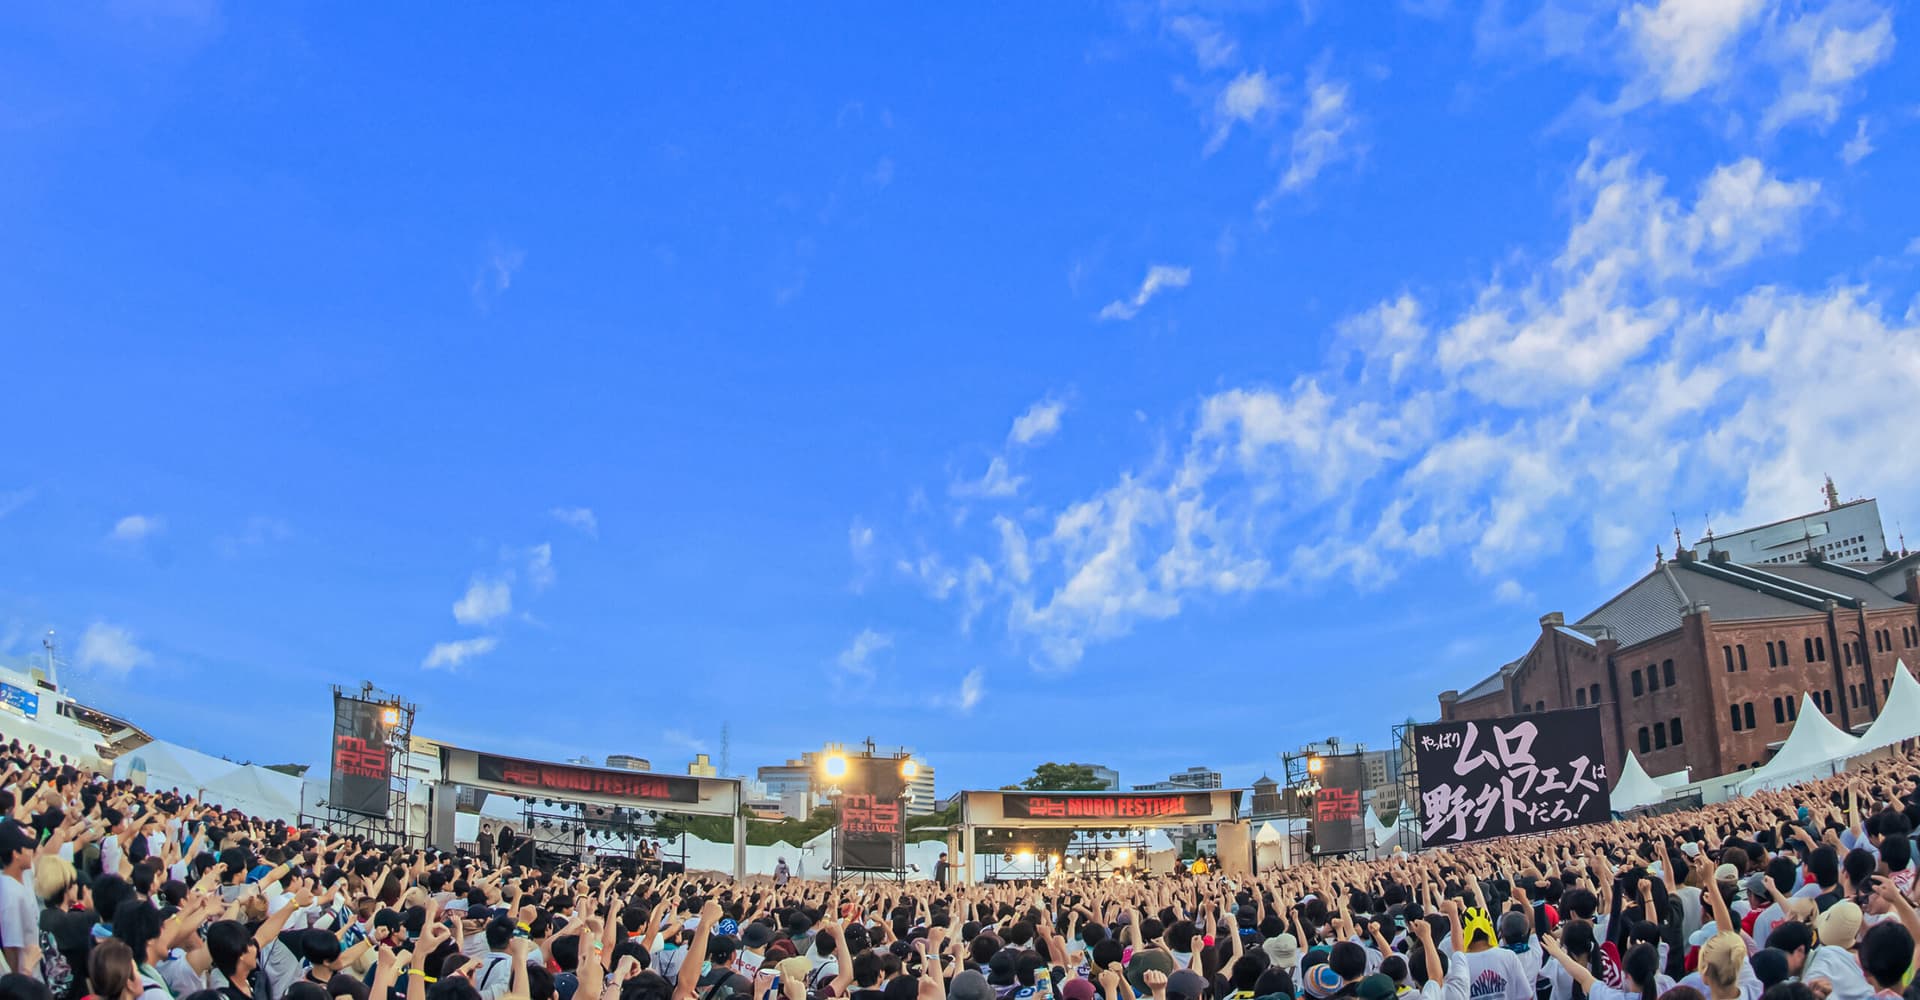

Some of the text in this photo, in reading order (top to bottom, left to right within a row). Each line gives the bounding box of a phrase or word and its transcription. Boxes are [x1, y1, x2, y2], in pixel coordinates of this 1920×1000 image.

[1421, 732, 1461, 752] やっぱり
[1068, 799, 1115, 816] MURO
[1118, 796, 1187, 816] FESTIVAL
[842, 823, 897, 833] FESTIVAL
